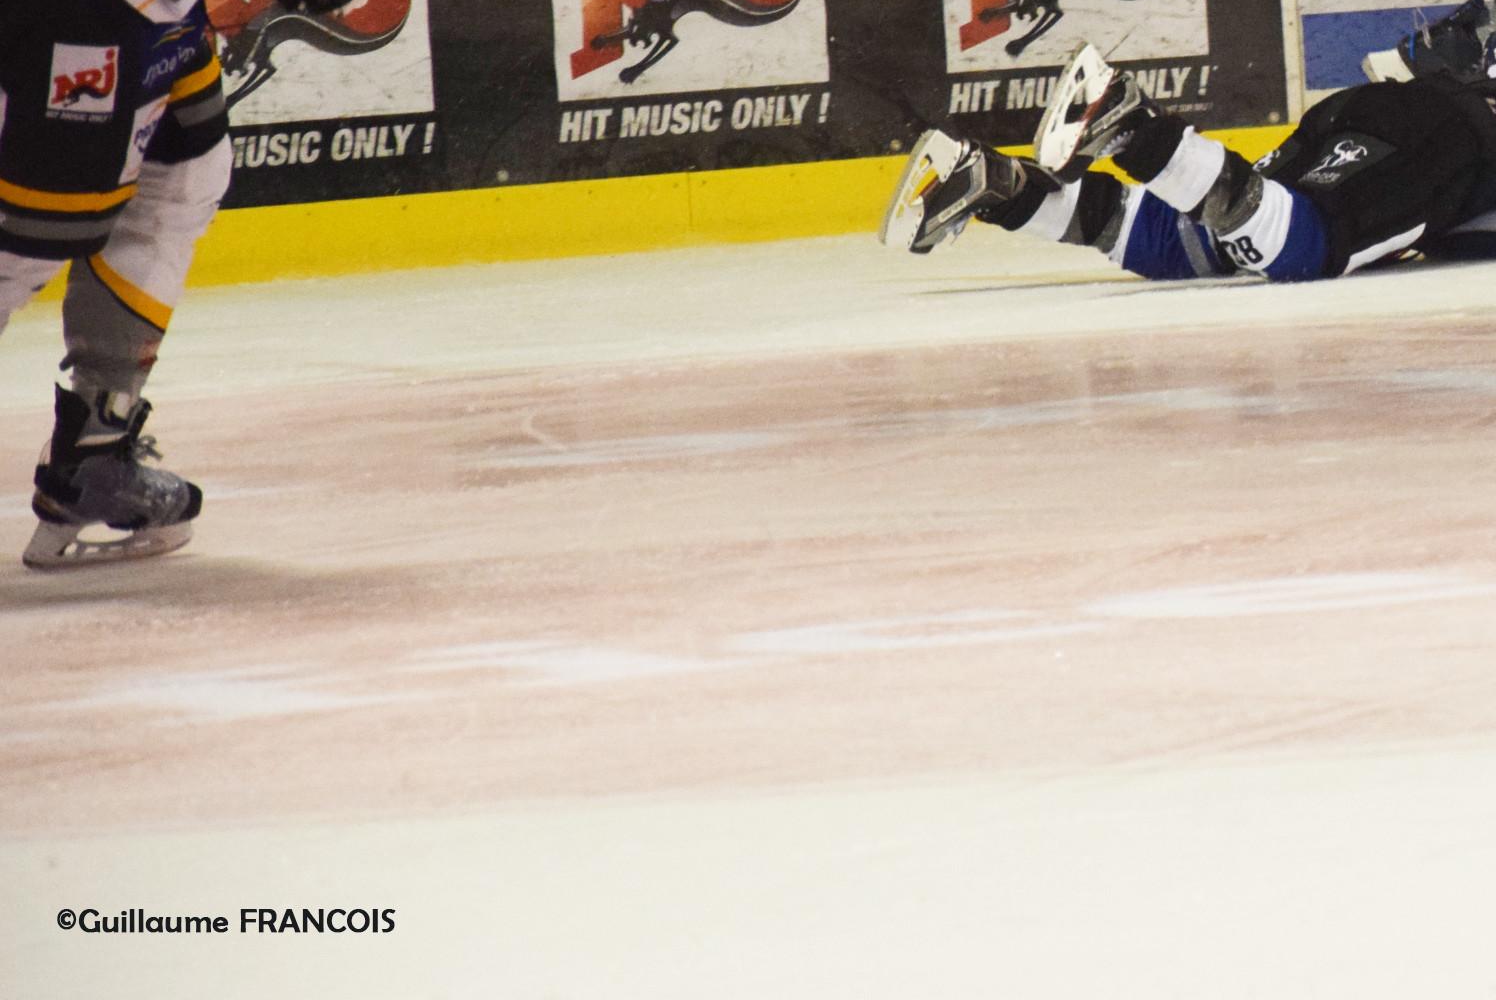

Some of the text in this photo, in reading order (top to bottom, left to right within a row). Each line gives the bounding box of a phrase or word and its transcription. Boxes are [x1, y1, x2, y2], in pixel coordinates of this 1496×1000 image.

[948, 79, 1001, 115] HIT
[558, 108, 614, 144] HIT
[619, 99, 724, 139] MUSIC
[730, 93, 812, 131] ONLY
[330, 122, 416, 163] ONLY
